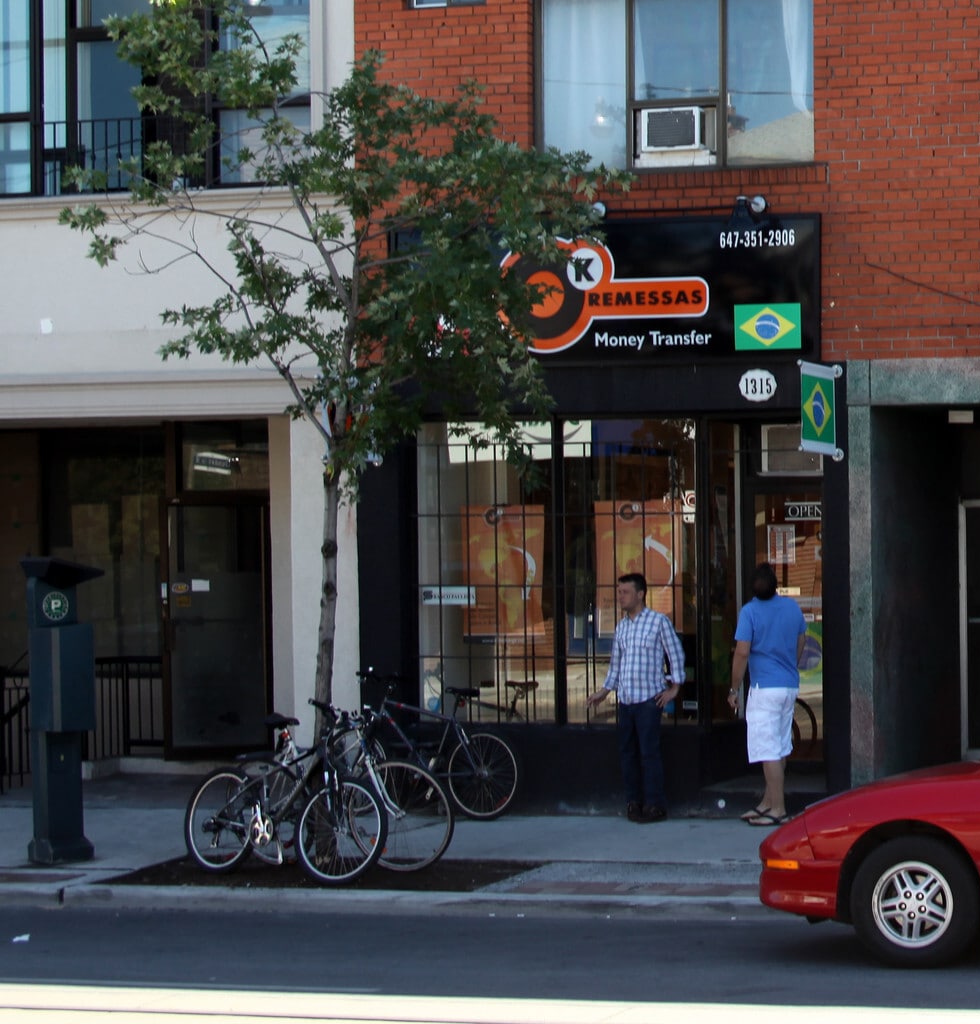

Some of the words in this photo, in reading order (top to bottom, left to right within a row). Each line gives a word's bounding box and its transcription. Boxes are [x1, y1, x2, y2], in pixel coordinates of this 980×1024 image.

[719, 228, 796, 249] 647-351-2906
[587, 289, 703, 307] REMESSAS
[594, 331, 645, 350] Money
[649, 329, 712, 346] Transfer
[743, 373, 773, 395] 1315
[788, 504, 821, 518] OPEN
